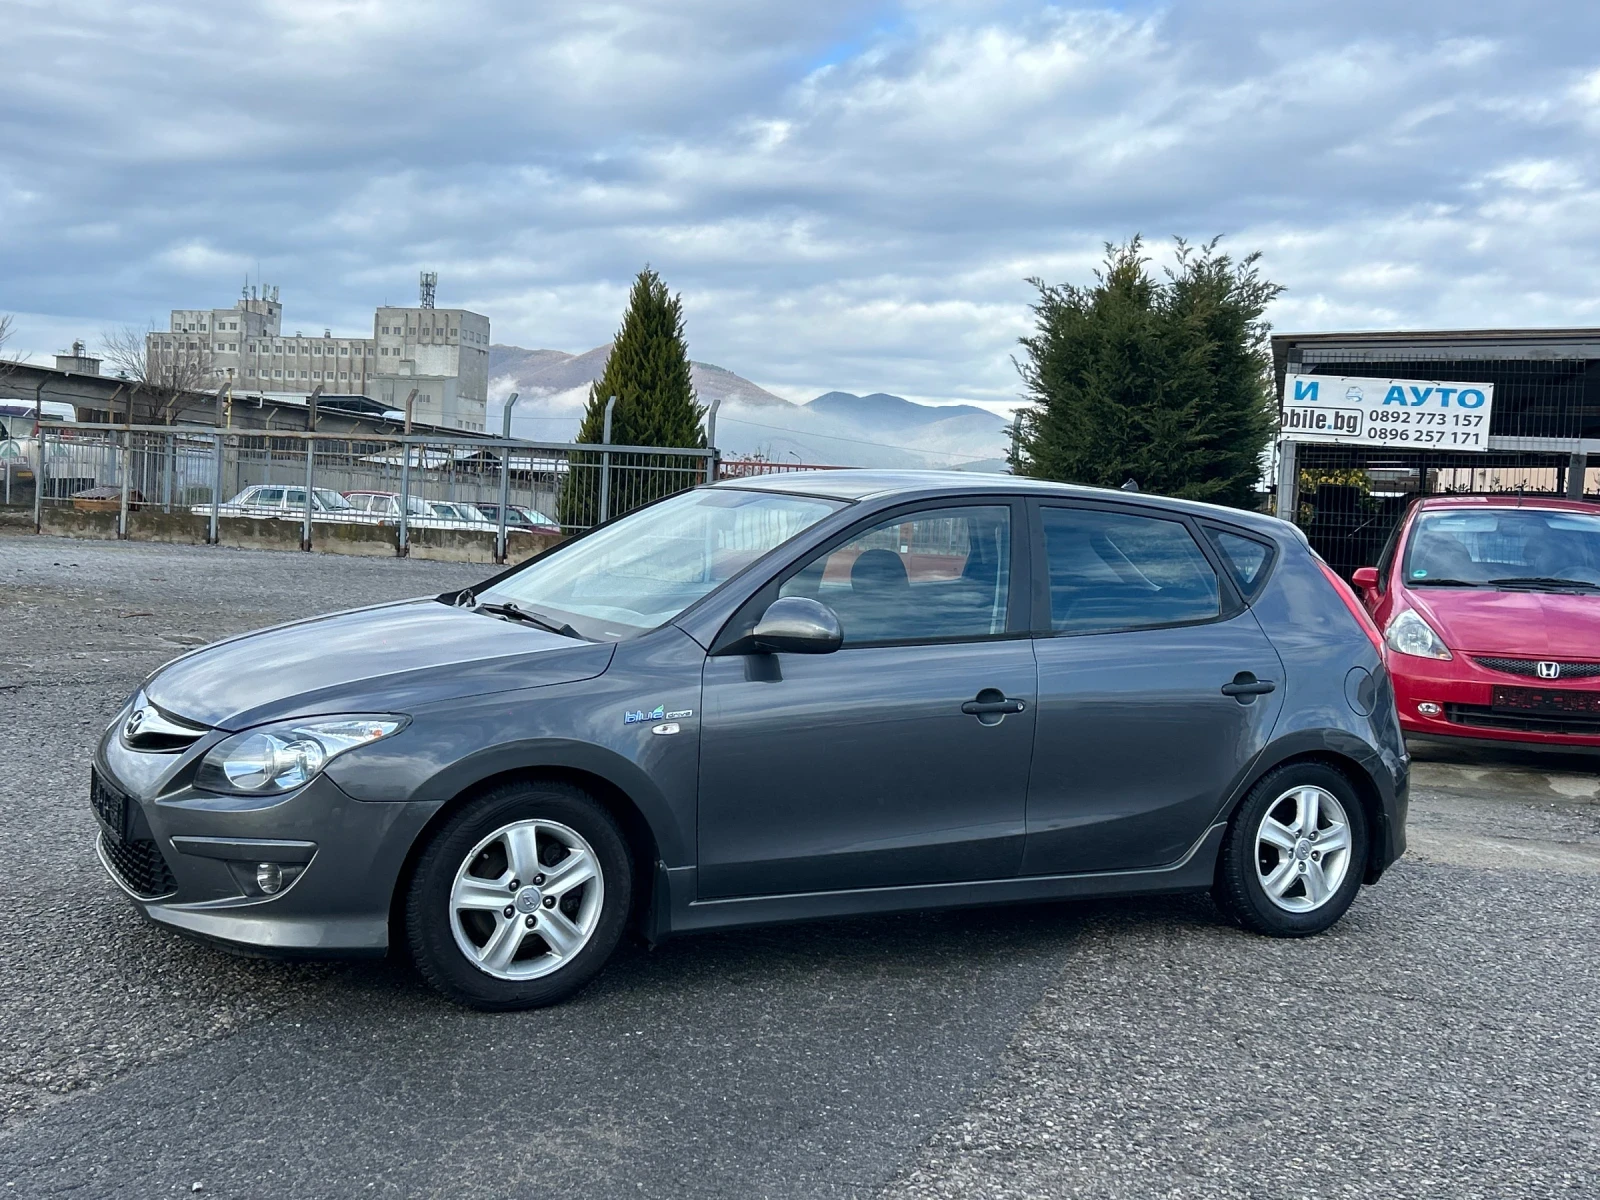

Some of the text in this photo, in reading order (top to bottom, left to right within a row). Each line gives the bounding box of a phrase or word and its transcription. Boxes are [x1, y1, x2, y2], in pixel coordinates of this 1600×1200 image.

[1294, 381, 1485, 409] И АУТО
[1369, 410, 1484, 427] 0892 773 157
[1367, 427, 1480, 445] 0896 257 171
[624, 710, 664, 724] blue
